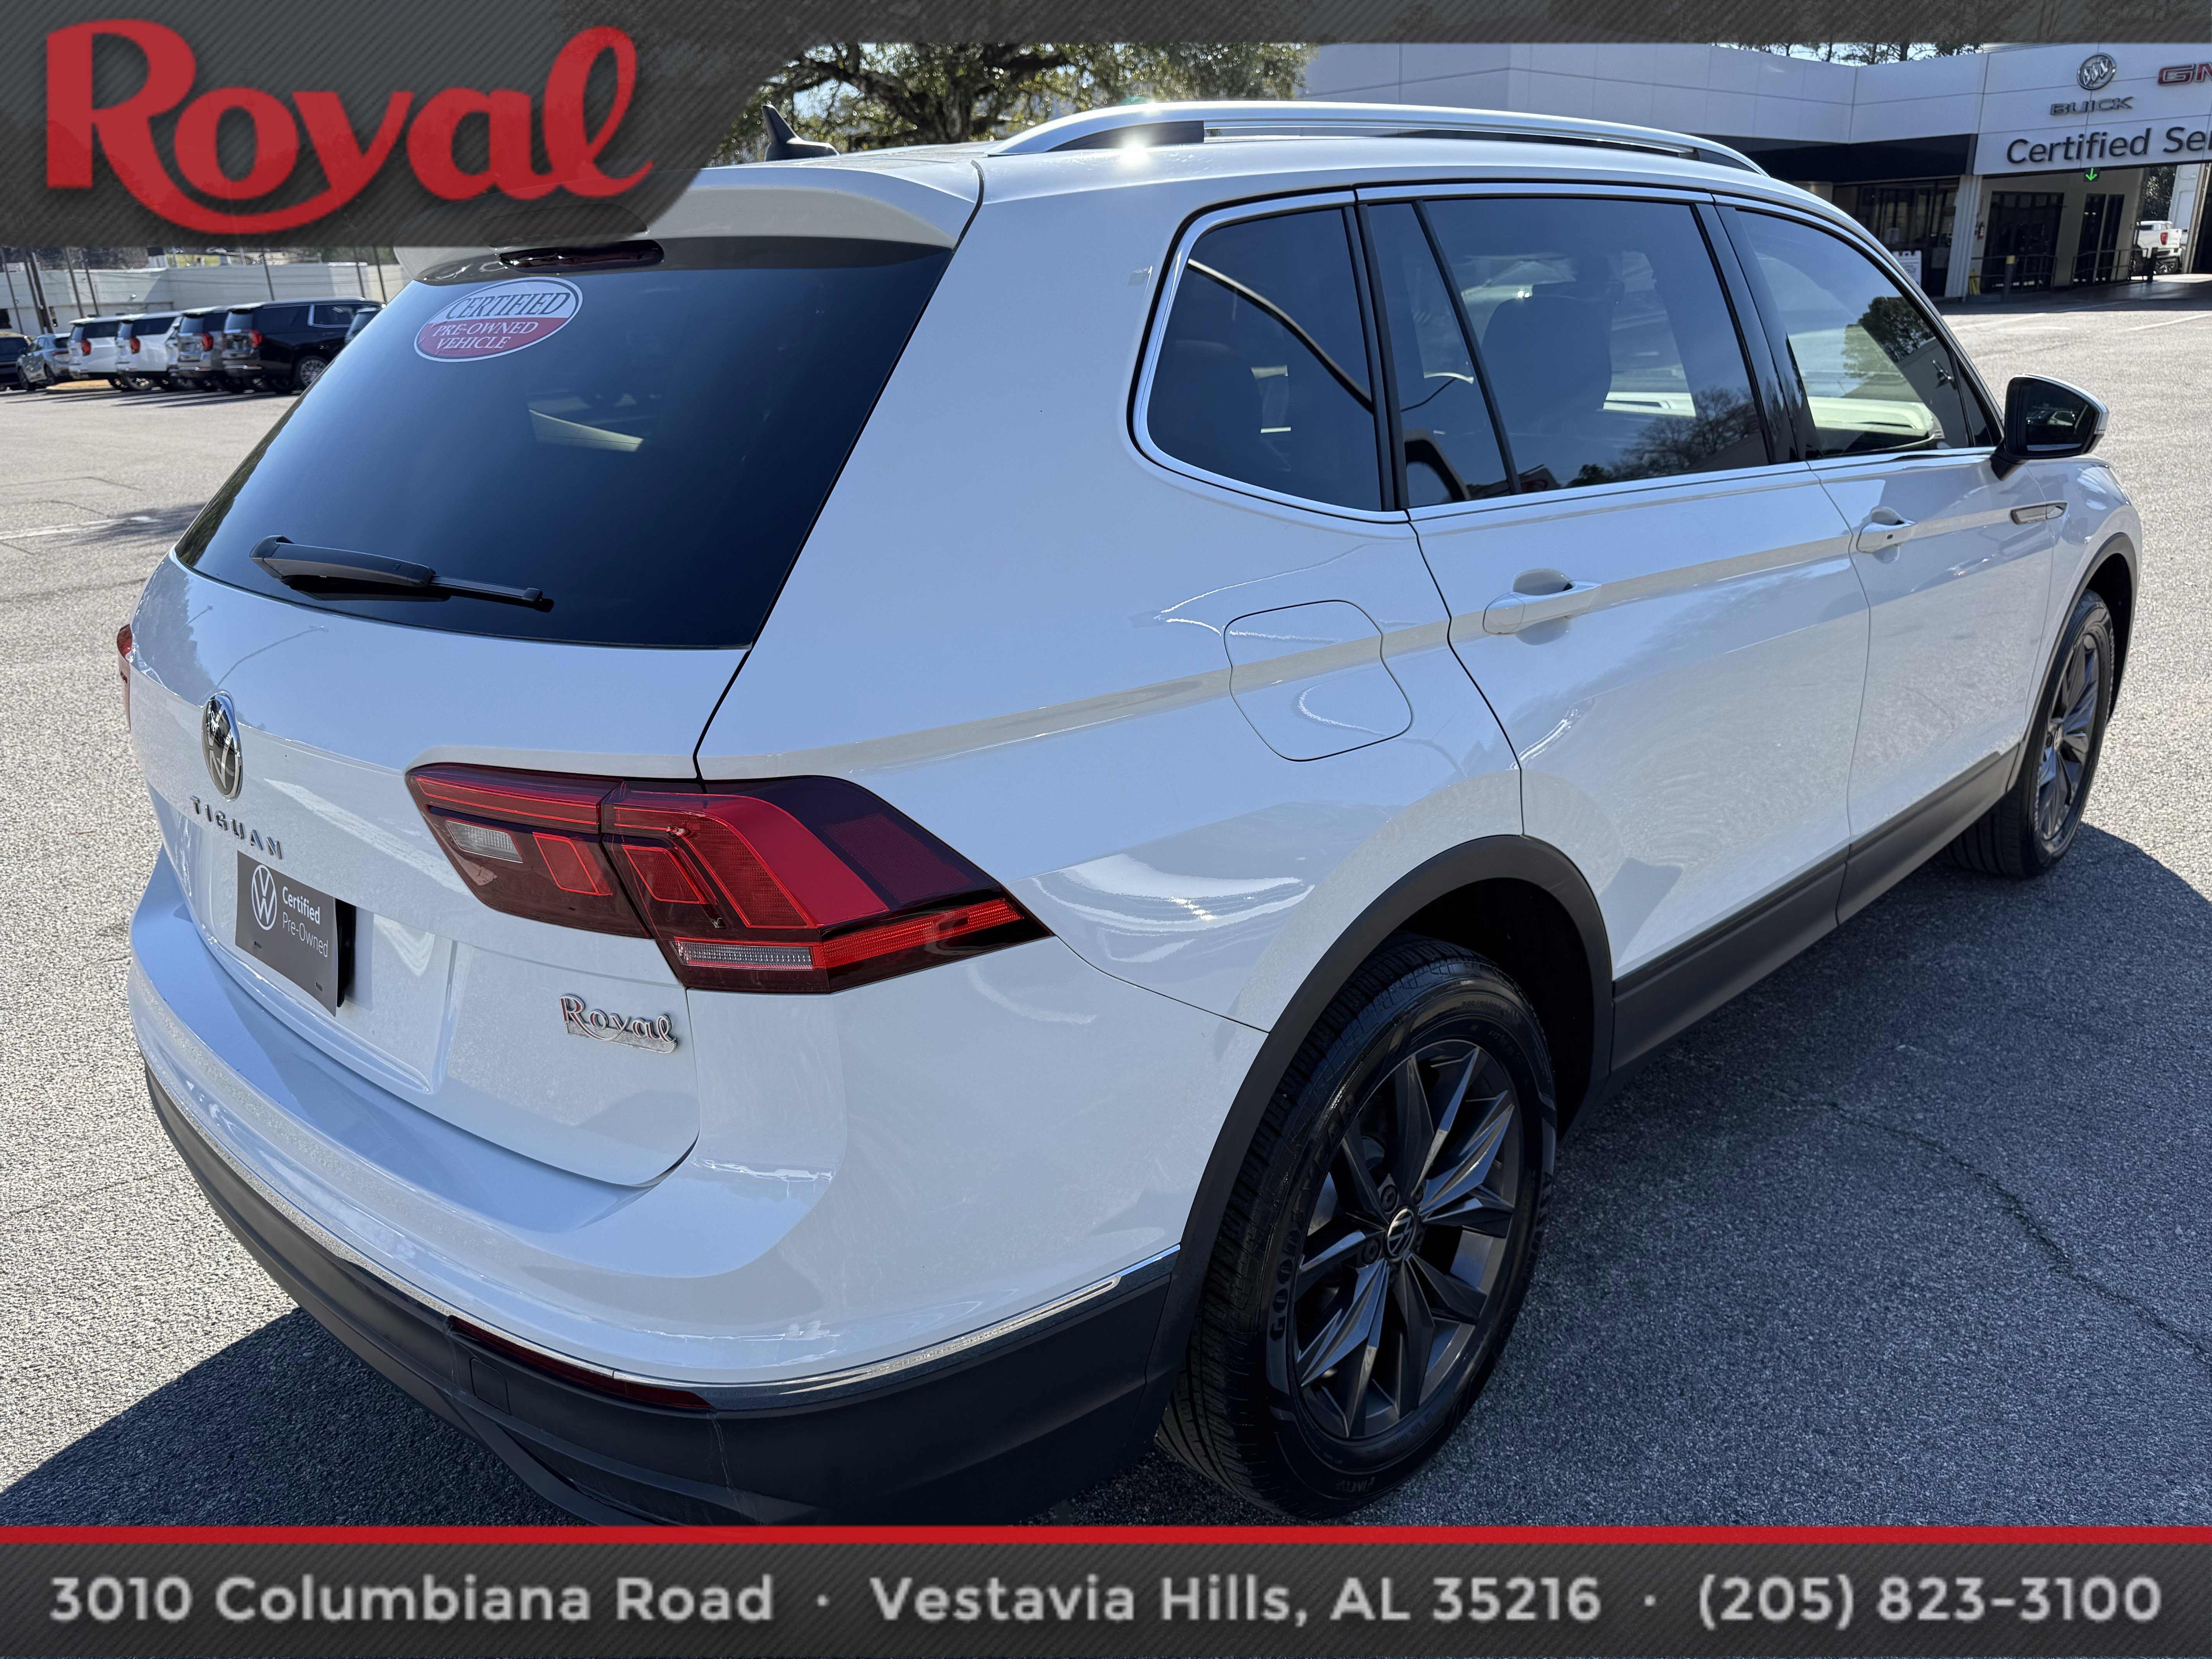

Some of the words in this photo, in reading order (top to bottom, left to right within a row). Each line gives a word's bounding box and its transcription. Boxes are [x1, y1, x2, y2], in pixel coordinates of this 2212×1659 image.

[2050, 96, 2133, 115] BUICK
[2006, 127, 2151, 164] Certified
[446, 292, 571, 319] CERTIFIED
[432, 322, 539, 337] PRE-OWNED
[436, 336, 512, 349] VEHICLE
[190, 795, 283, 860] TIGUAN
[282, 886, 320, 924] Certified
[282, 911, 328, 958] Pre-Owned
[560, 993, 678, 1044] Royal
